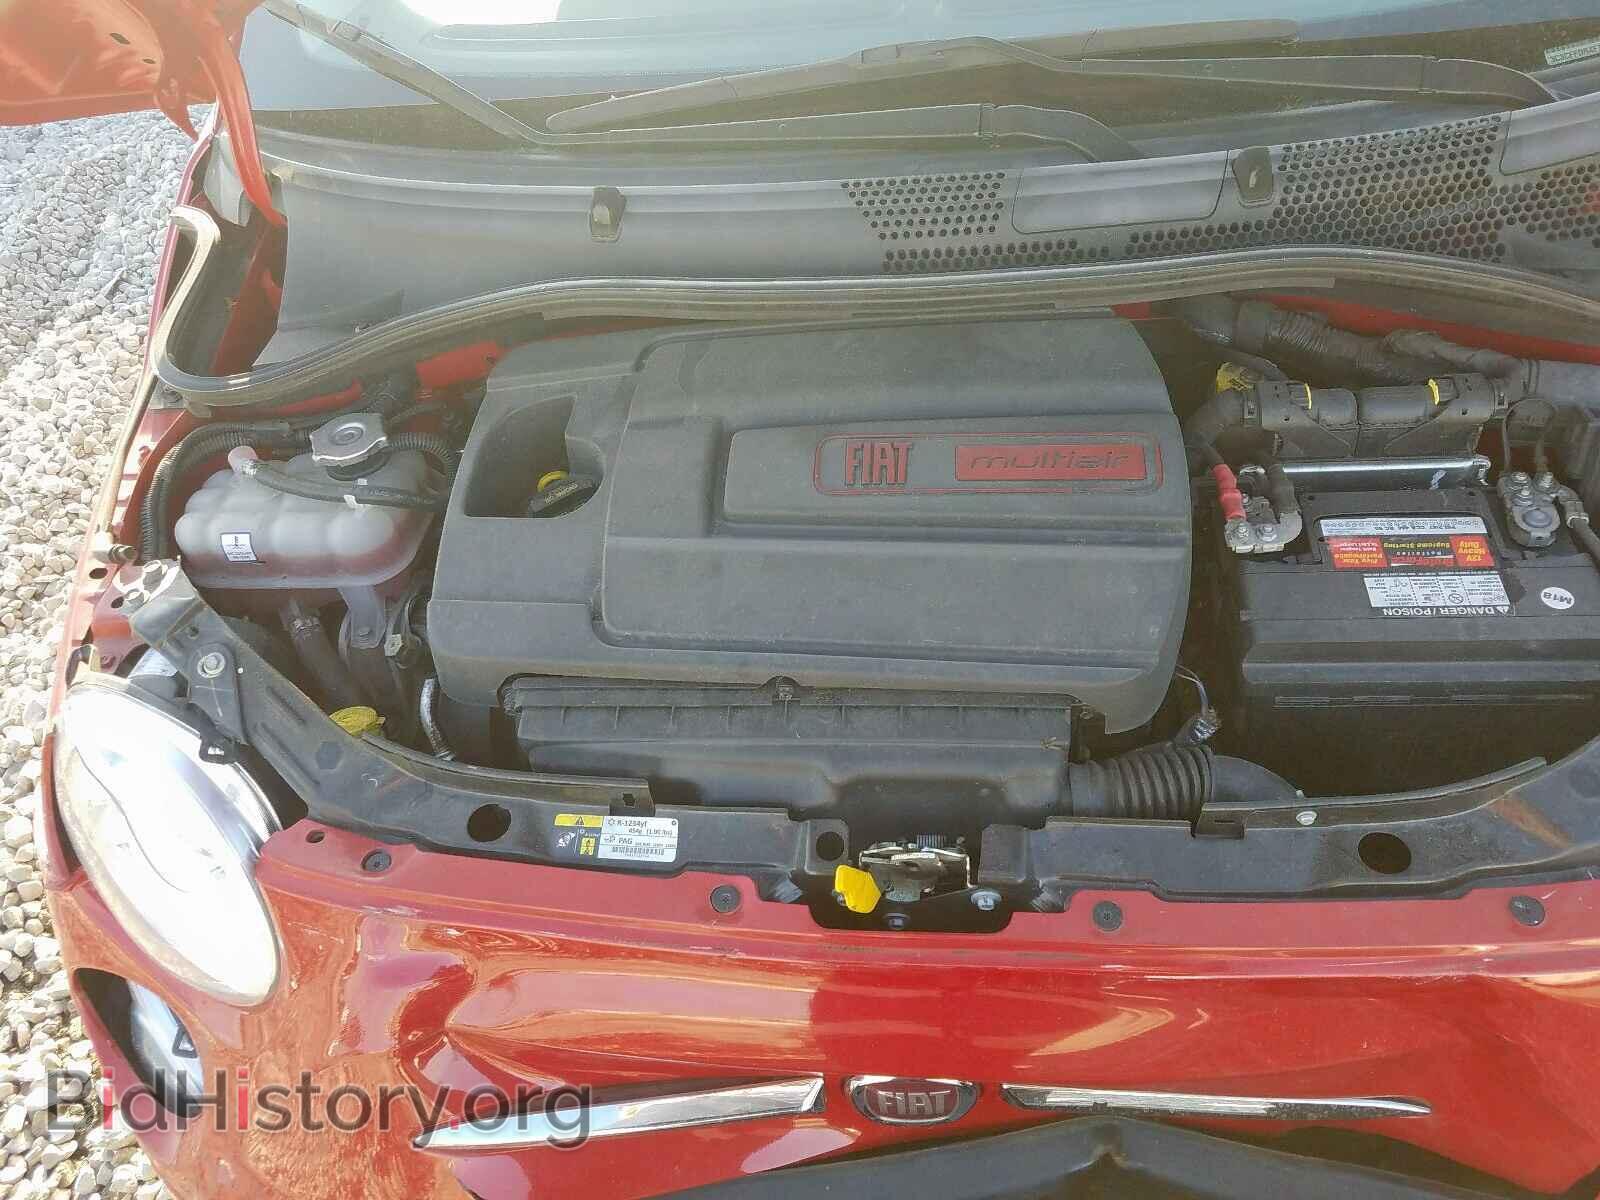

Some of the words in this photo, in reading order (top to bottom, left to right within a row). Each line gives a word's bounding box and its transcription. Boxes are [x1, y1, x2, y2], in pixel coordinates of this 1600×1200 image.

[845, 441, 914, 487] FIAT
[970, 451, 1130, 470] multiair
[1543, 591, 1572, 605] M18
[1383, 607, 1432, 616] POISON
[1440, 606, 1495, 615] DANGER
[878, 1089, 951, 1116] FIAT
